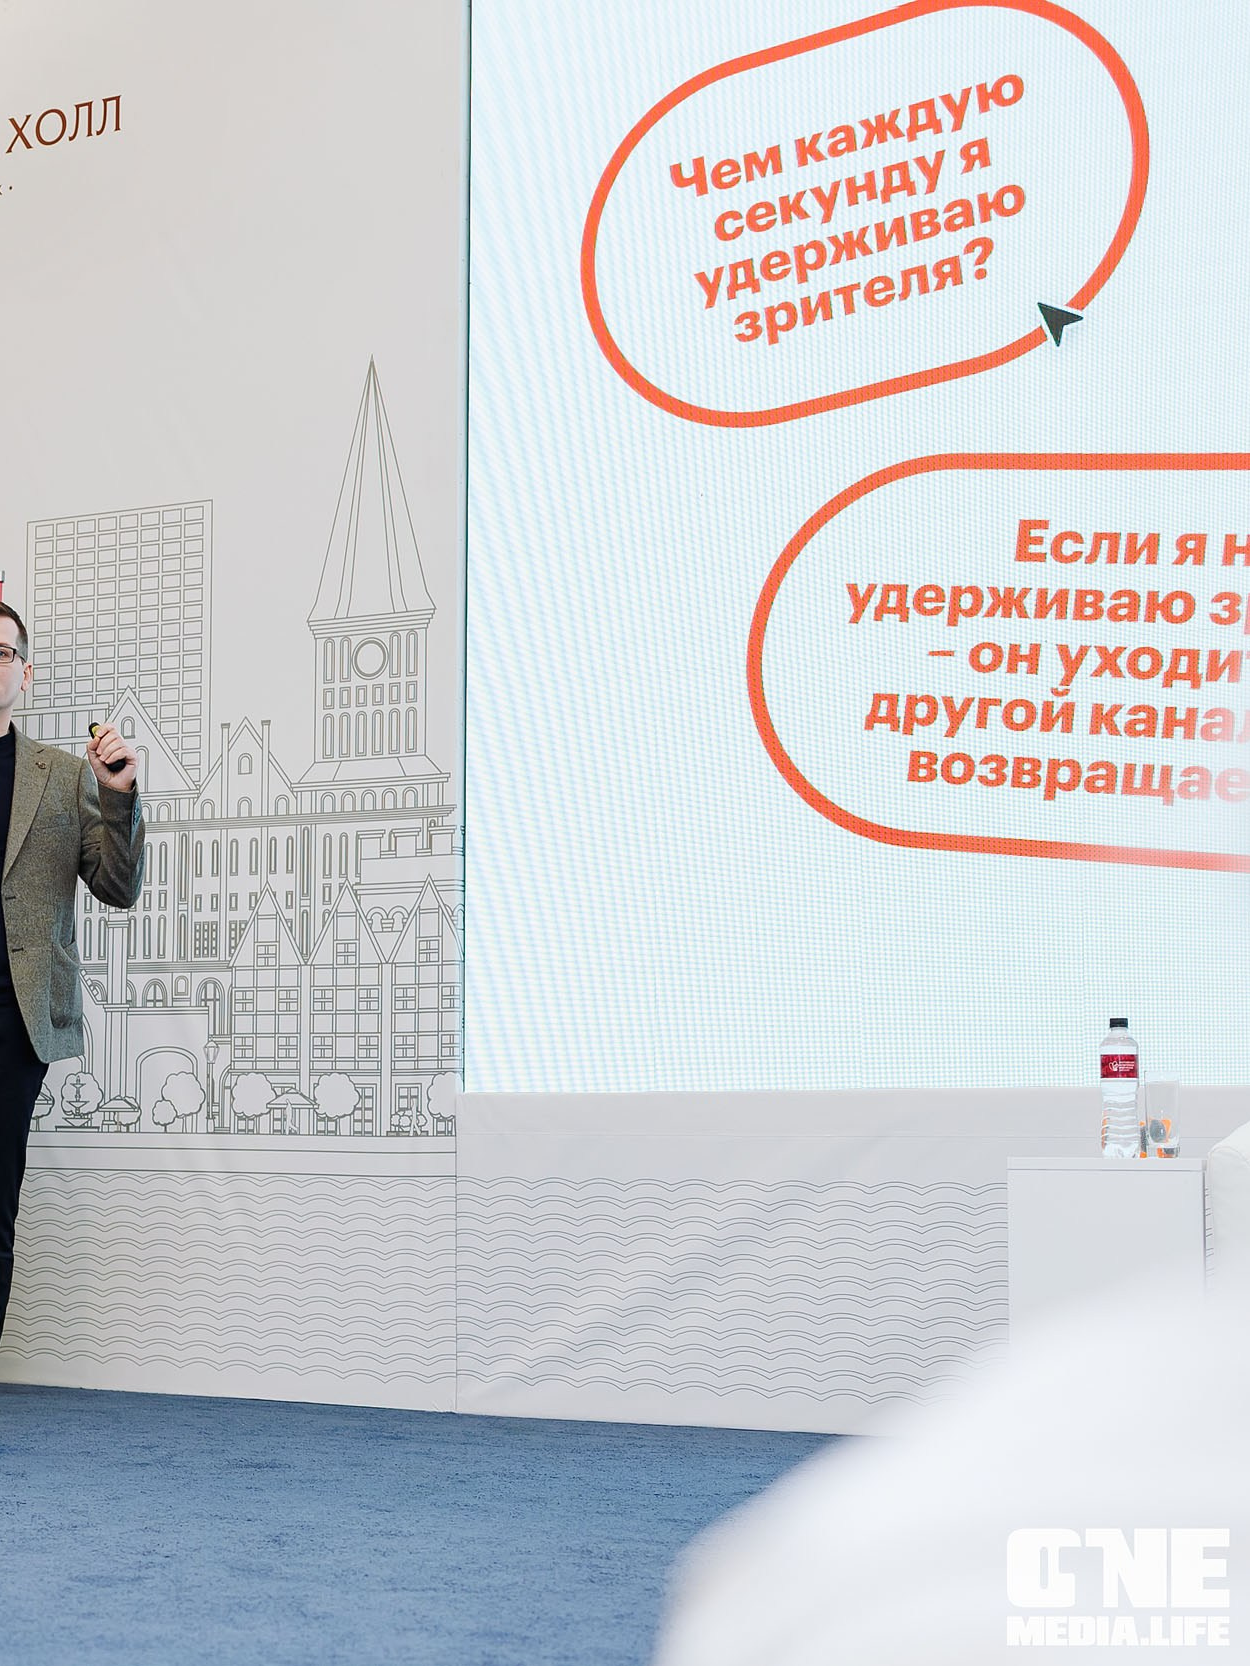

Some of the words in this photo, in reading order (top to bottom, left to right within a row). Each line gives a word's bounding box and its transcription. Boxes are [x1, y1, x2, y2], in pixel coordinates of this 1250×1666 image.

[669, 143, 783, 198] Чем
[795, 74, 1025, 168] каждую
[714, 150, 945, 242] секунду
[960, 137, 992, 172] я
[694, 184, 1026, 308] удерживаю
[734, 237, 995, 345] зрителя?
[1014, 518, 1161, 566] Если
[1171, 533, 1208, 566] я
[846, 581, 1196, 627] удерживаю
[1209, 591, 1250, 635] з
[968, 641, 1041, 675] он
[1056, 643, 1250, 689] уходи
[864, 687, 1075, 737] другой
[907, 750, 1250, 807] возвращае
